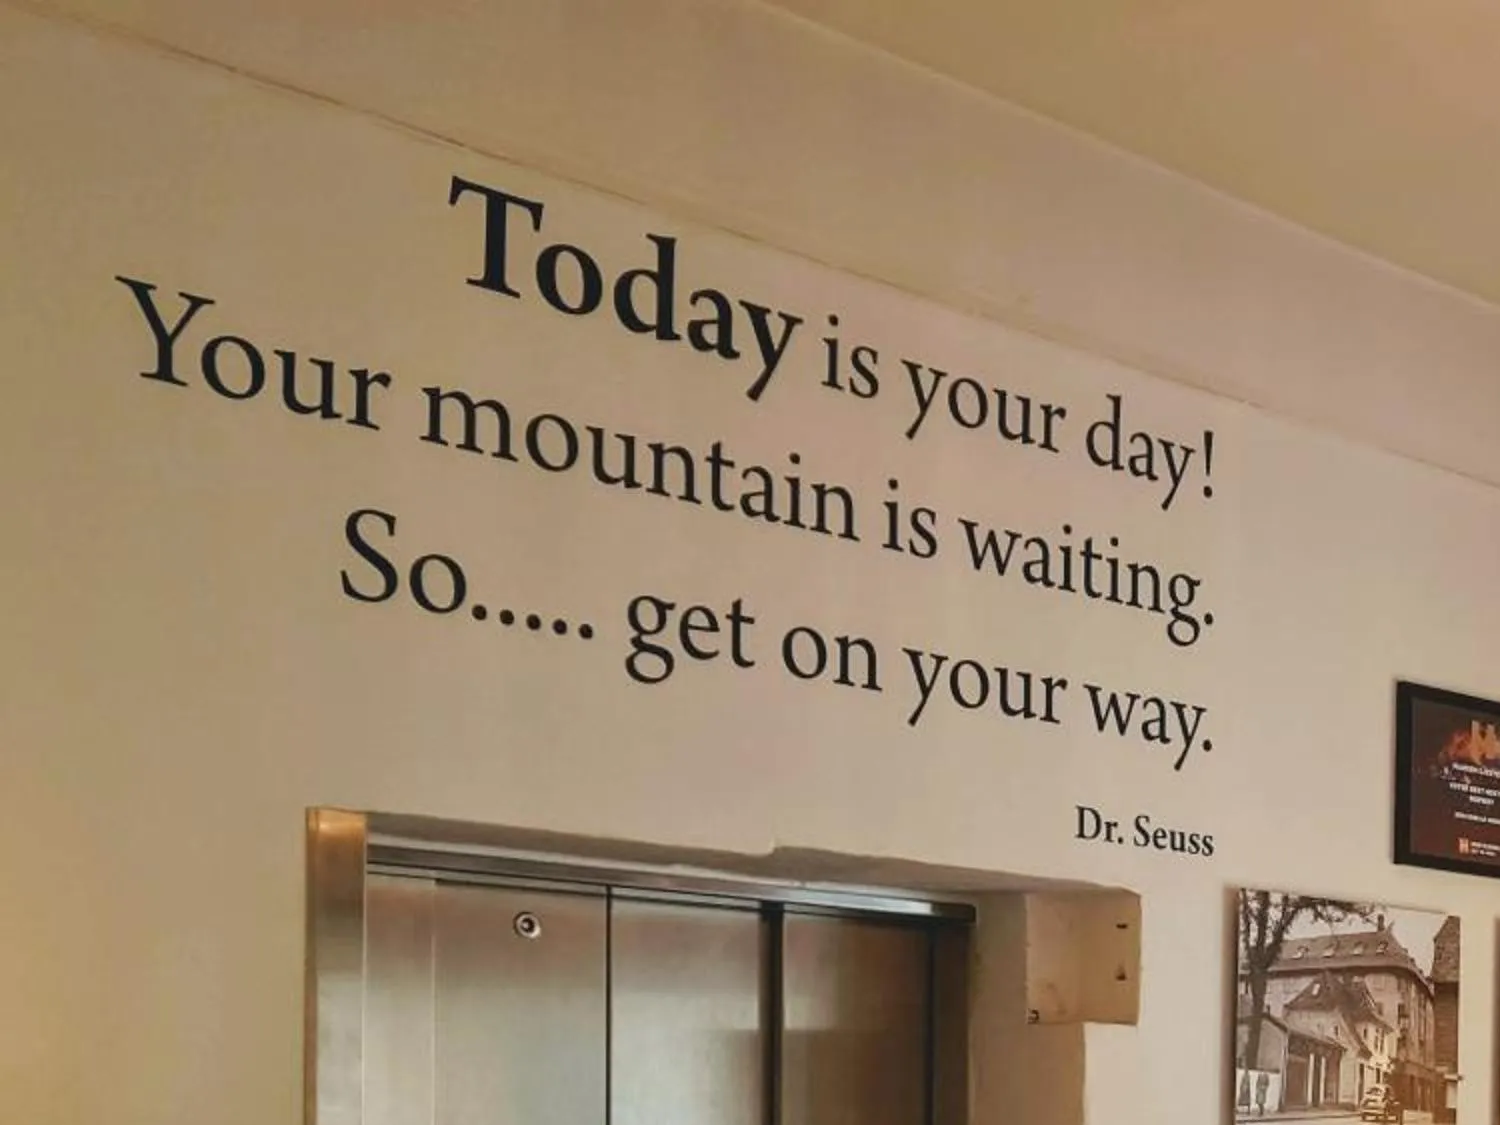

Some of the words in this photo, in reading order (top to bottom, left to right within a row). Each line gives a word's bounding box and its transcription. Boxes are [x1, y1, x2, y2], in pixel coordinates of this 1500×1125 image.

[114, 274, 392, 432] Your
[419, 385, 861, 542] mountain
[881, 478, 938, 559] is
[957, 517, 1215, 647] waiting.
[448, 174, 803, 402] Today
[821, 313, 880, 399] is
[900, 358, 1067, 453] your
[1085, 394, 1215, 511] day!
[339, 507, 595, 641] So.....
[624, 594, 756, 685] get
[781, 625, 883, 693] on
[901, 646, 1069, 727] your
[1083, 682, 1214, 772] way.
[1074, 804, 1125, 844] Dr.
[1132, 814, 1215, 857] Seuss
